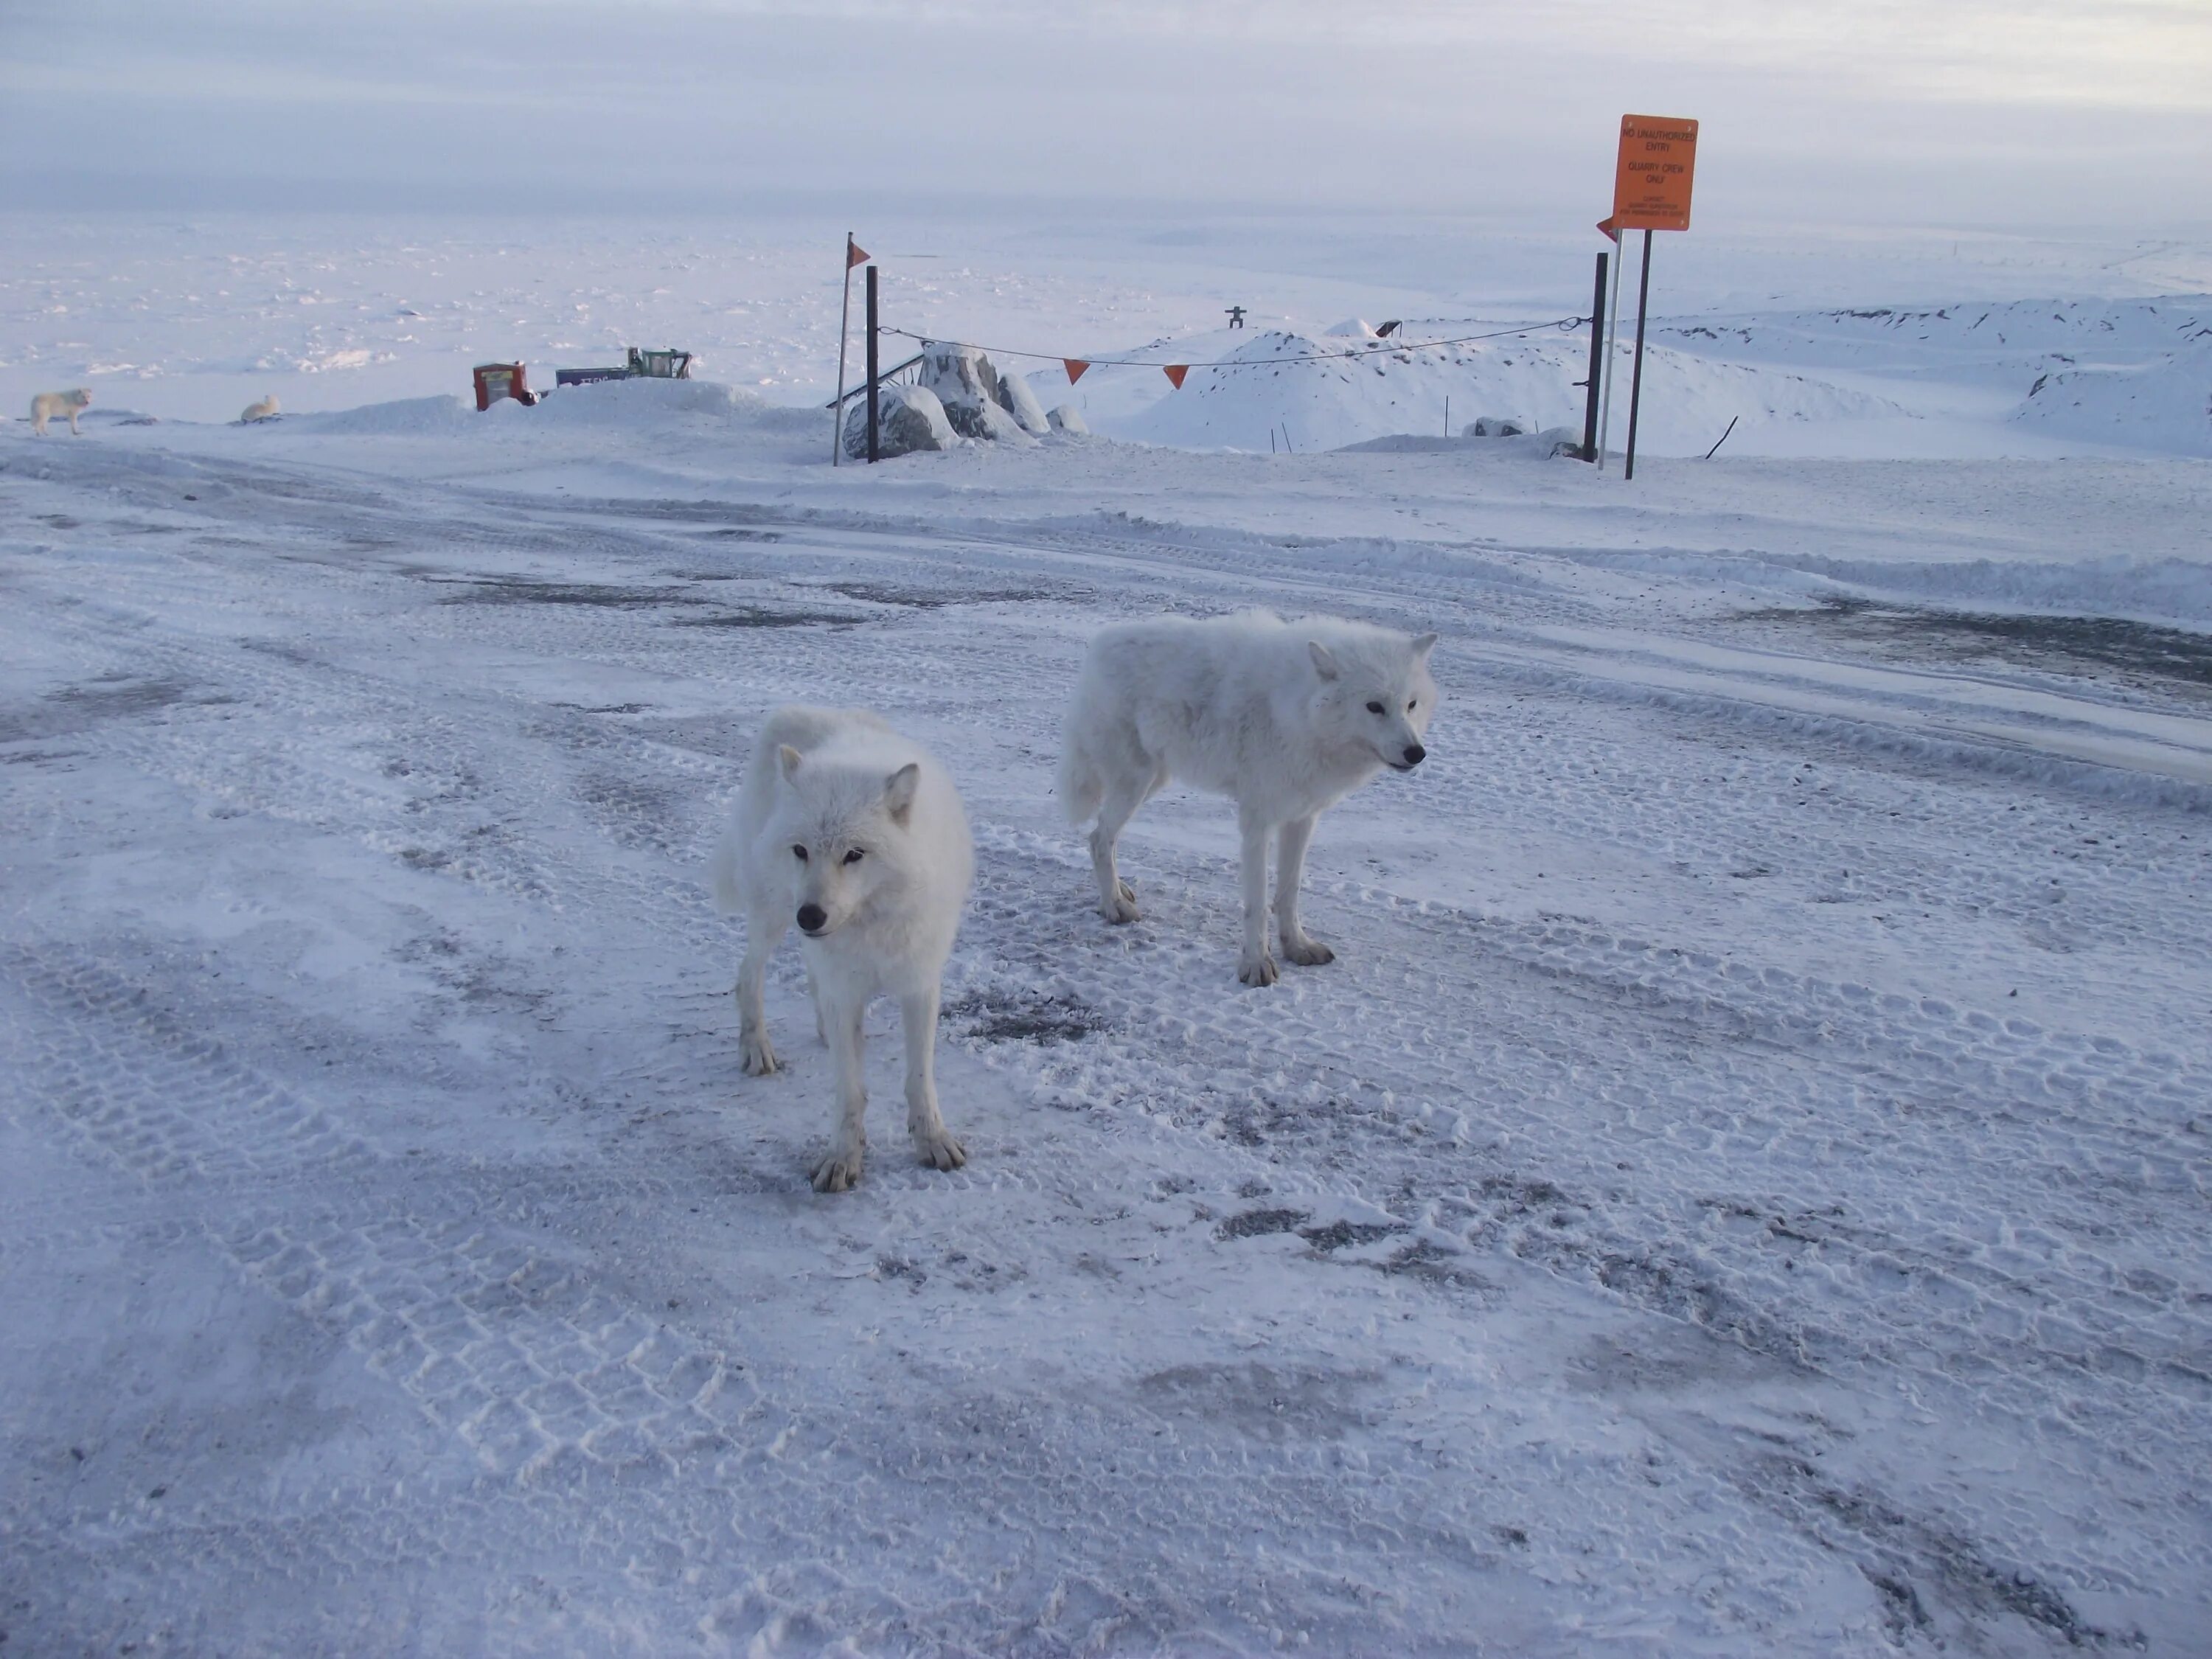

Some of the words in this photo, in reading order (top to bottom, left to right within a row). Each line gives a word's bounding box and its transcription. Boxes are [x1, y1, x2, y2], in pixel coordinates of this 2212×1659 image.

[1623, 128, 1635, 137] NO
[1637, 130, 1695, 142] UNAUTHORIZED
[1646, 142, 1670, 152] ENTRY
[1628, 161, 1660, 172] QUARRY
[1662, 164, 1684, 173] CREW
[1646, 175, 1666, 184] ONLY
